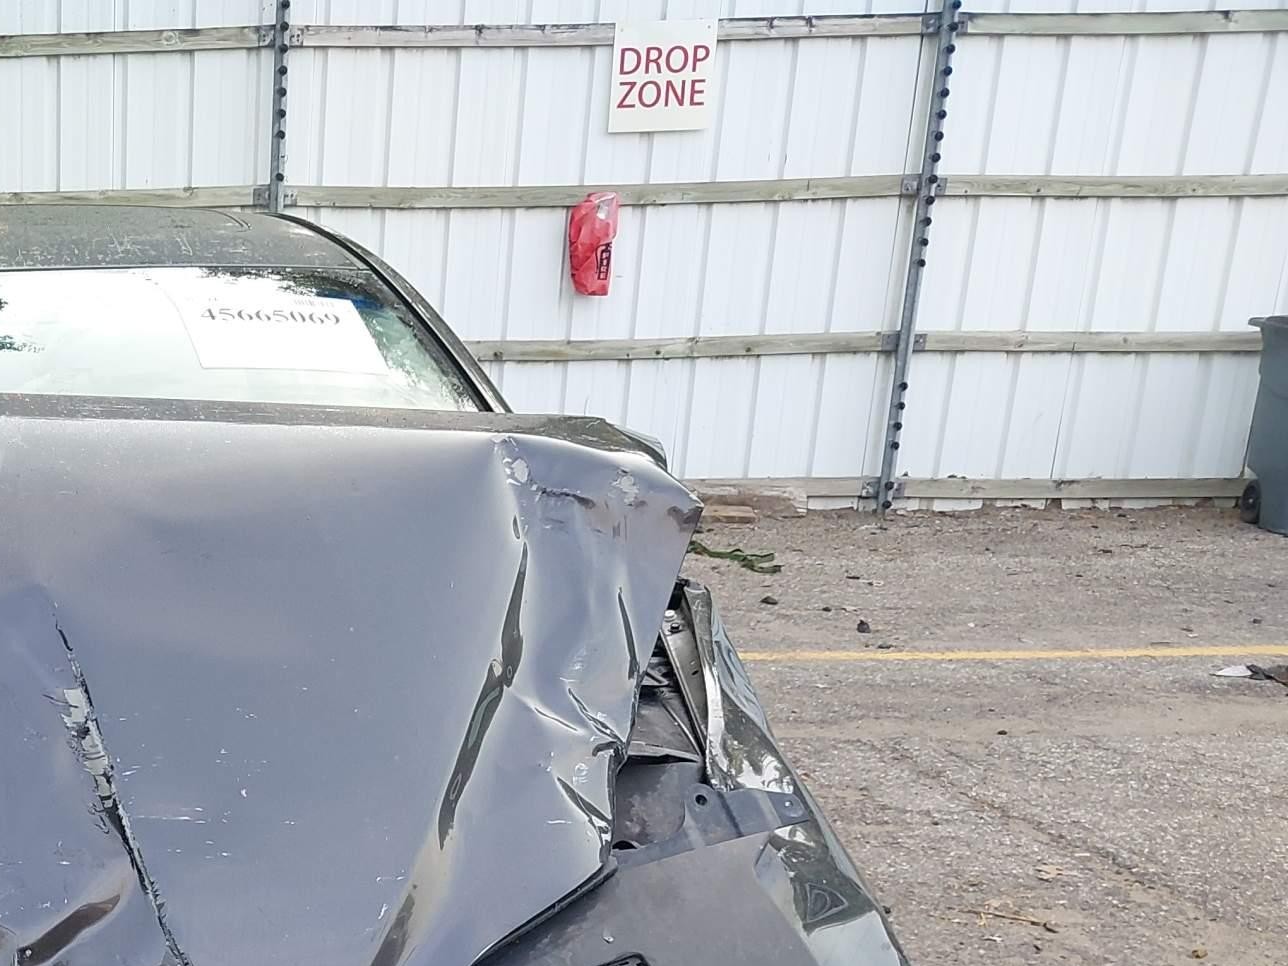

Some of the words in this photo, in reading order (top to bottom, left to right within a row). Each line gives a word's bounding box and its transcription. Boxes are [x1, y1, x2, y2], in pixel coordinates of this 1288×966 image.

[619, 45, 710, 75] DROP
[616, 79, 706, 108] ZONE
[200, 307, 341, 325] 45665069
